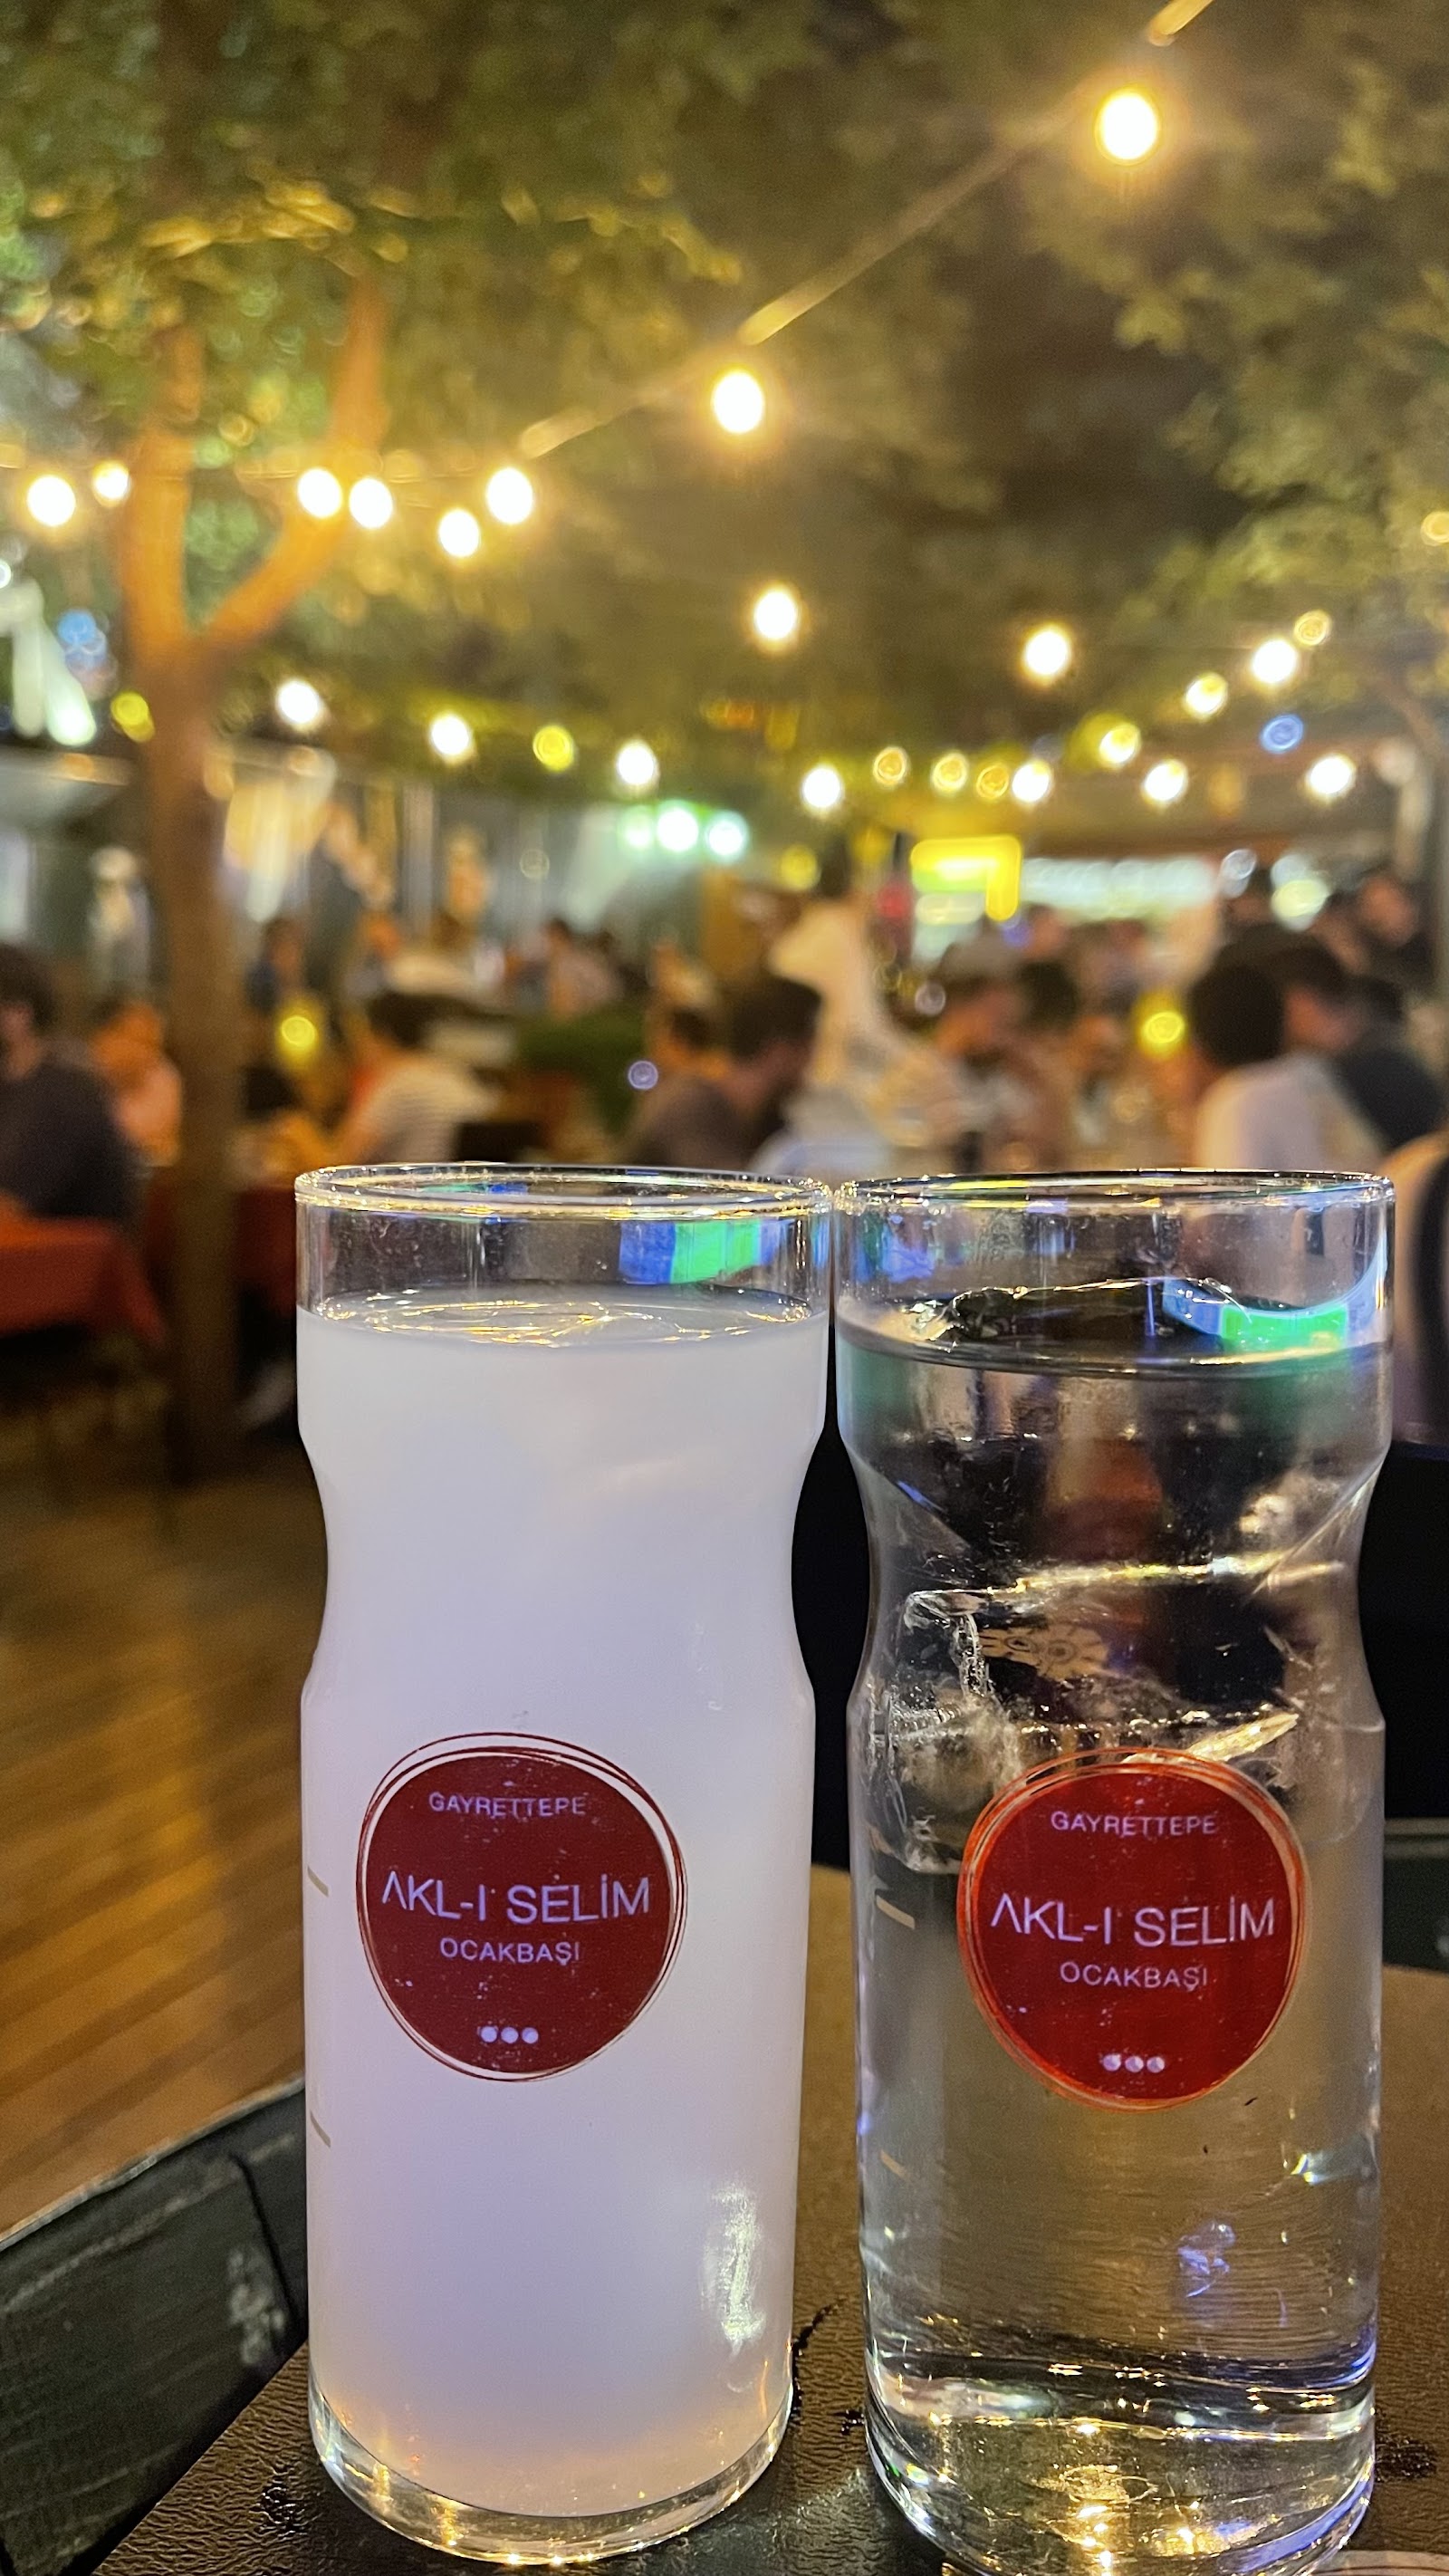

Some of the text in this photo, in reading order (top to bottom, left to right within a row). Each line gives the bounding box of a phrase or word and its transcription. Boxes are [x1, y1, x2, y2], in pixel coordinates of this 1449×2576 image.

[428, 1792, 587, 1817] GAYRETTEPE
[1051, 1811, 1218, 1836] GAYRETTEPE
[506, 1873, 649, 1924] SELİM
[1134, 1896, 1274, 1946] SELİM
[439, 1937, 581, 1966] OCAKBAŞI
[1060, 1961, 1207, 1991] OCAKBAŞI
